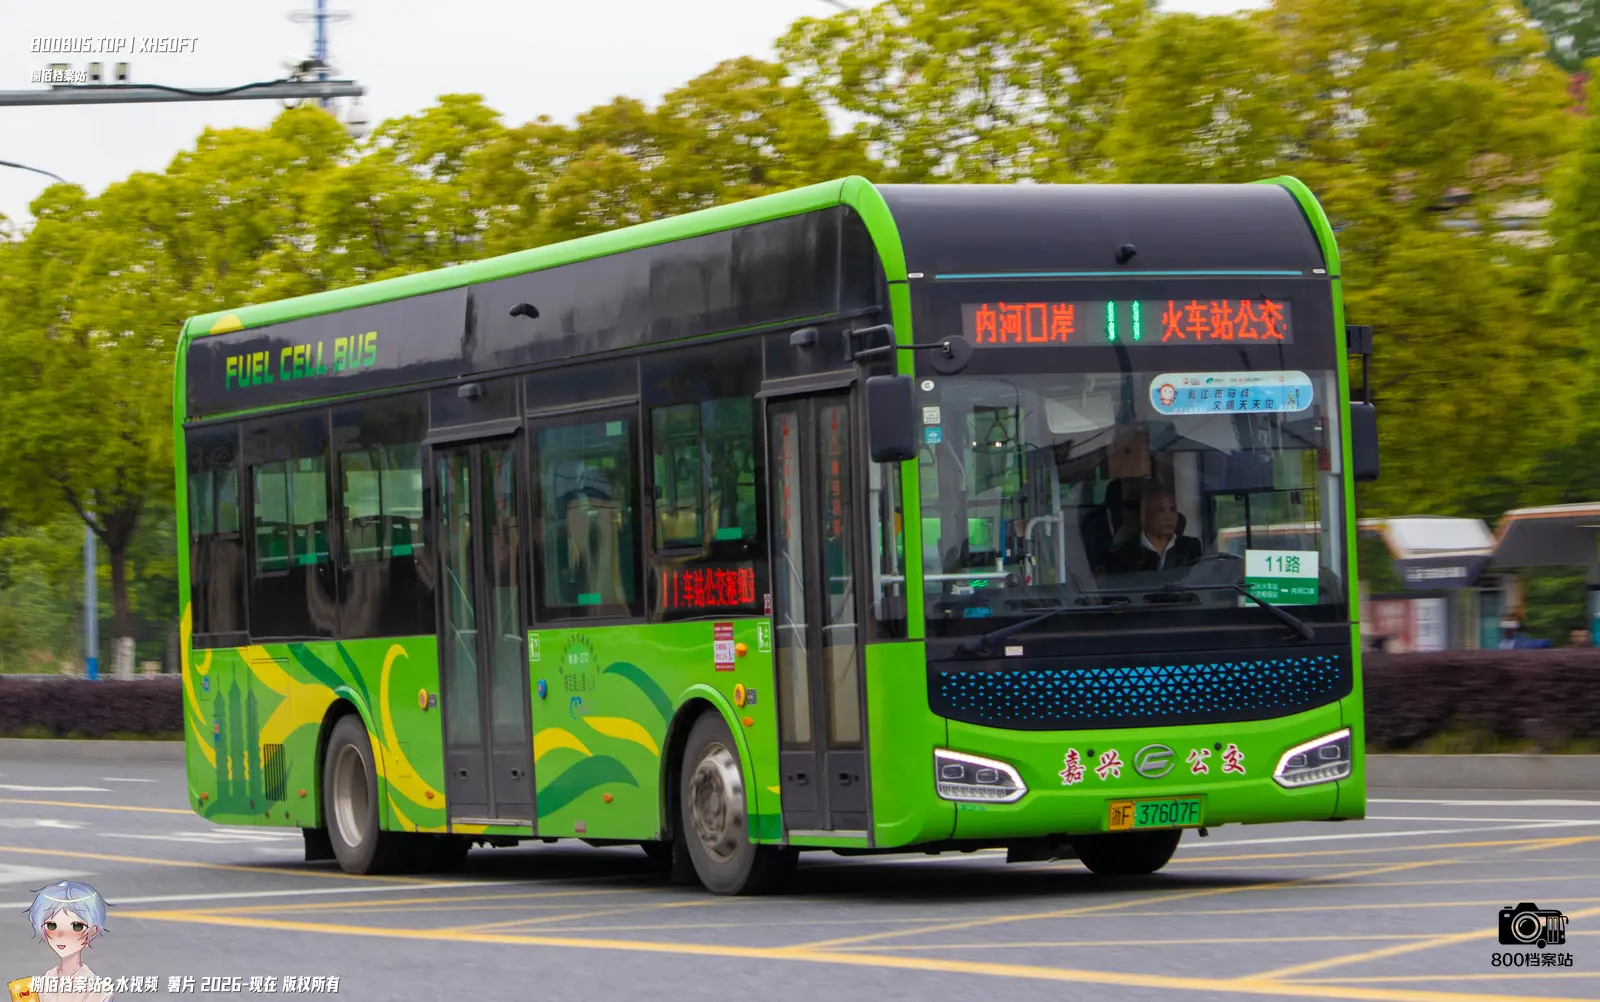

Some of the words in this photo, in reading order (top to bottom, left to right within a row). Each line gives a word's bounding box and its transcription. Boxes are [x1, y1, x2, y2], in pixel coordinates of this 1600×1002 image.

[975, 301, 1075, 343] 内河口岸
[1106, 301, 1140, 341] 11
[1161, 299, 1287, 342] 火车站公交
[225, 350, 275, 391] FUEL
[279, 340, 328, 382] CELL
[333, 331, 378, 373] BUS
[1265, 555, 1301, 573] 11路
[1059, 748, 1124, 785] 嘉兴
[1185, 744, 1246, 775] 公交
[1139, 801, 1199, 825] 37607F
